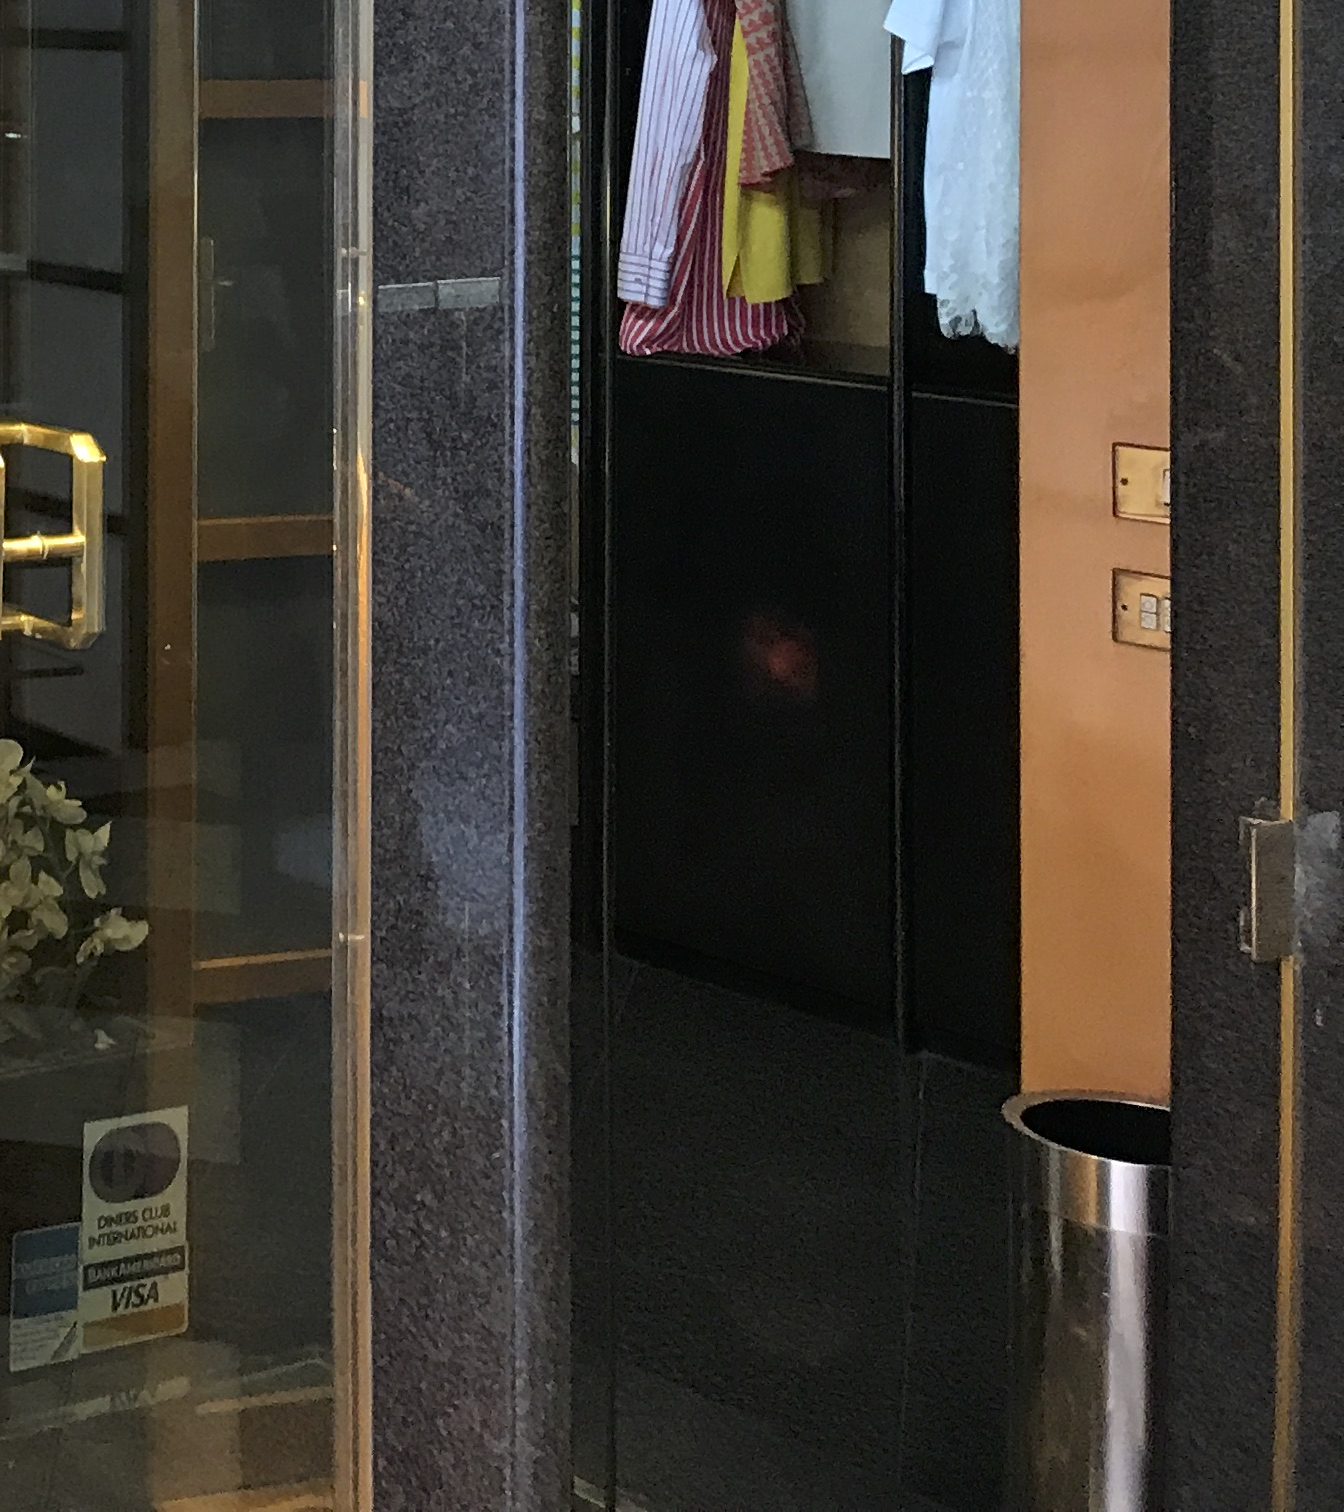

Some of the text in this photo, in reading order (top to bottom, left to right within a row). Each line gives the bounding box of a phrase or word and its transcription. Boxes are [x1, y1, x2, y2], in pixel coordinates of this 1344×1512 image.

[97, 1202, 171, 1231] DINERS CLUB
[87, 1220, 178, 1251] INTERNATIONAL
[111, 1280, 160, 1314] VISA
